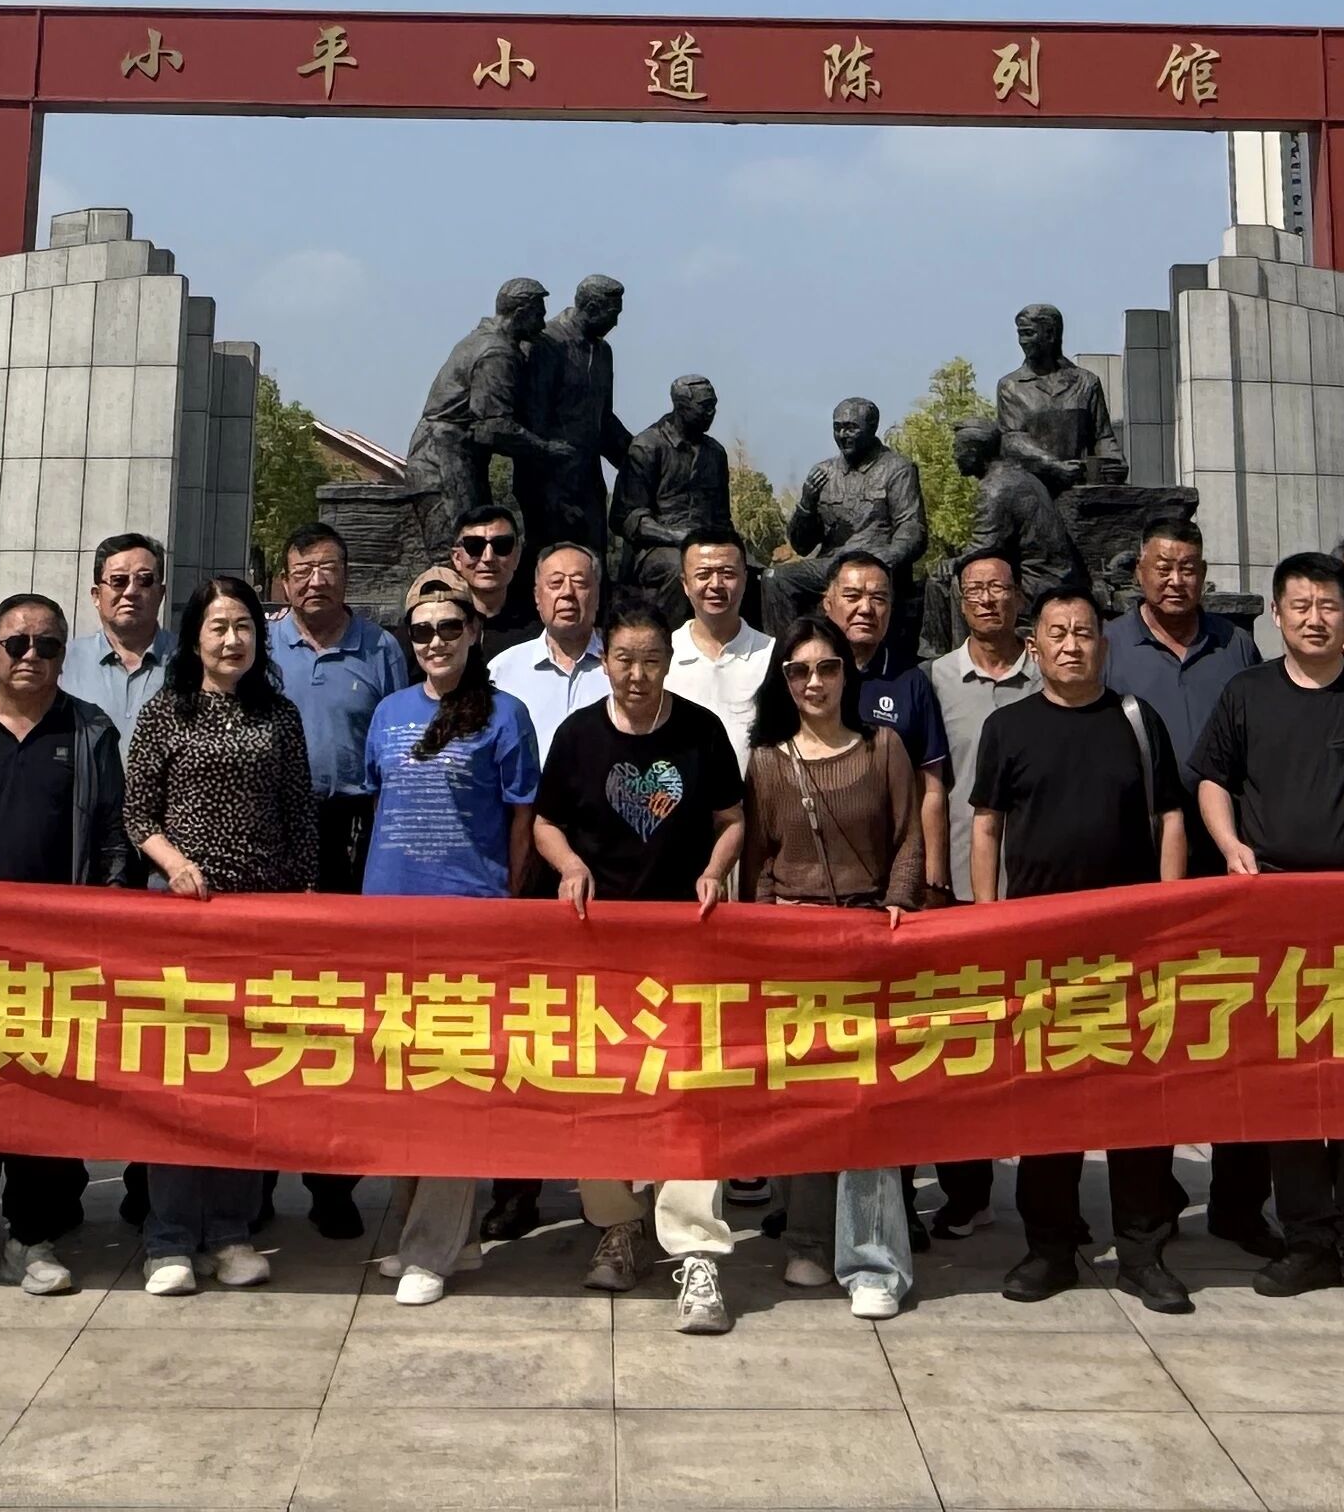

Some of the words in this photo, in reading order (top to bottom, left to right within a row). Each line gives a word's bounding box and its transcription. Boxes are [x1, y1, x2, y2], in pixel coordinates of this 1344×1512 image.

[121, 26, 1220, 106] 小平小道陈列馆
